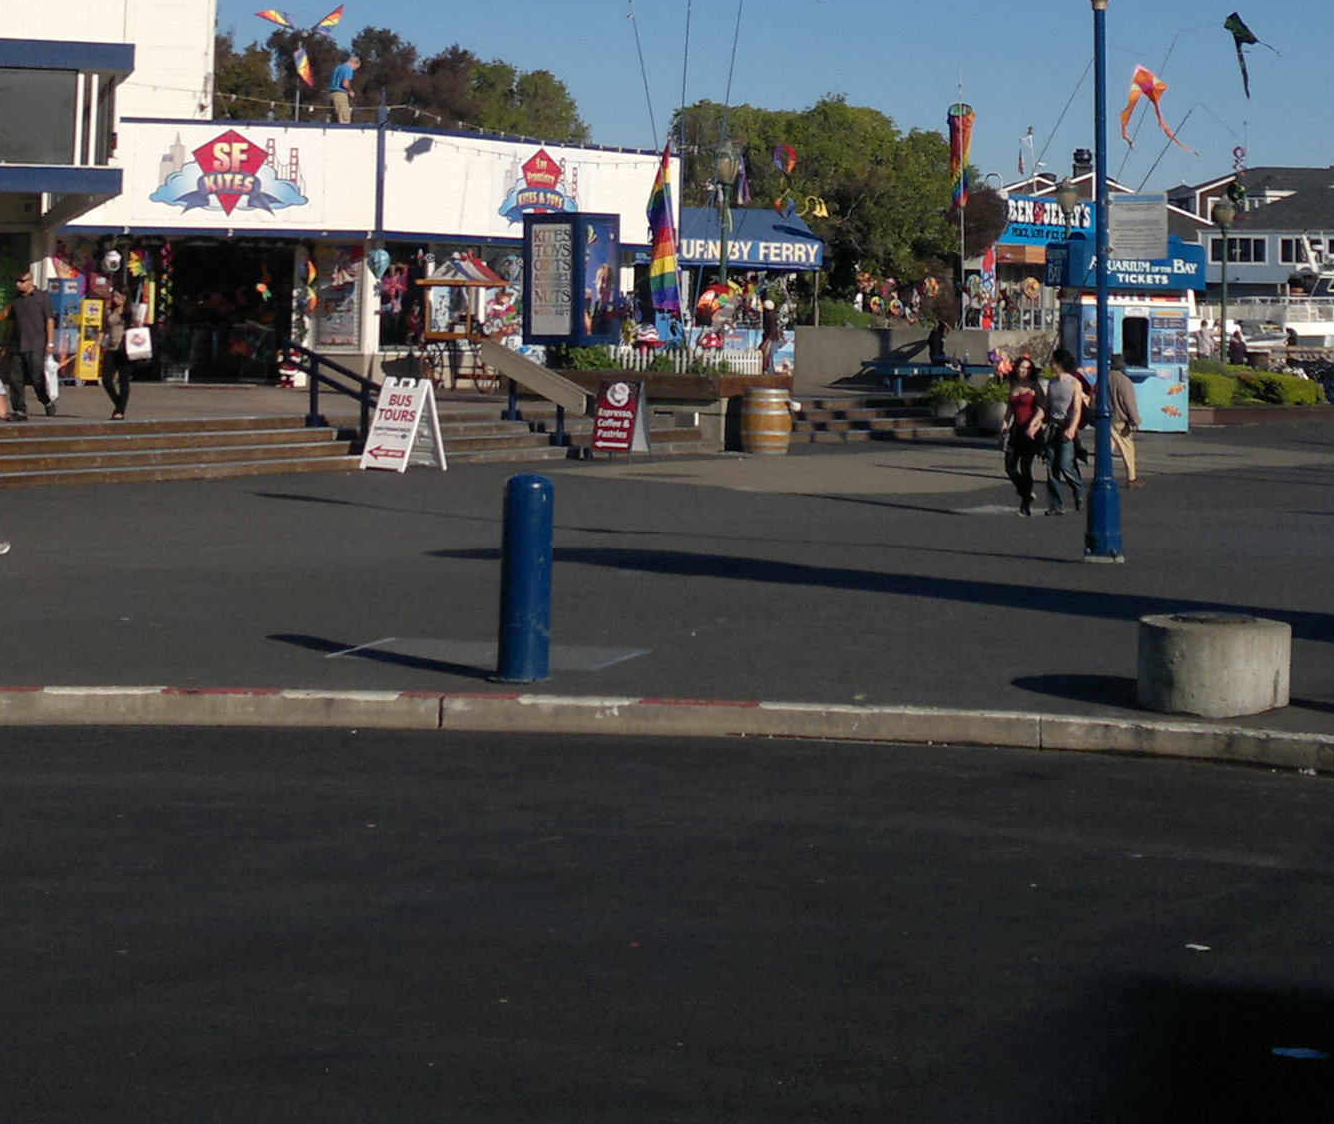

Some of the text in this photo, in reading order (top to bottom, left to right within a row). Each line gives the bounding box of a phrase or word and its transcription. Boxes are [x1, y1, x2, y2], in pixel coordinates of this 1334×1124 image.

[213, 142, 249, 172] SF
[203, 174, 255, 193] KITES
[518, 191, 563, 209] KITES & TOYS
[1008, 199, 1034, 223] BEN
[1044, 203, 1091, 228] JERY'S
[534, 229, 571, 242] KITES
[534, 244, 571, 258] TOYS
[681, 239, 819, 263] URN BY FERRY
[1088, 256, 1150, 274] AUARIUM
[1173, 259, 1198, 274] BAY
[1116, 274, 1169, 284] TICKETS
[388, 394, 412, 407] BUS
[378, 408, 417, 422] TOURS
[598, 408, 634, 419] Espresso,
[597, 418, 630, 428] Coffee &
[597, 429, 627, 439] Pastries
